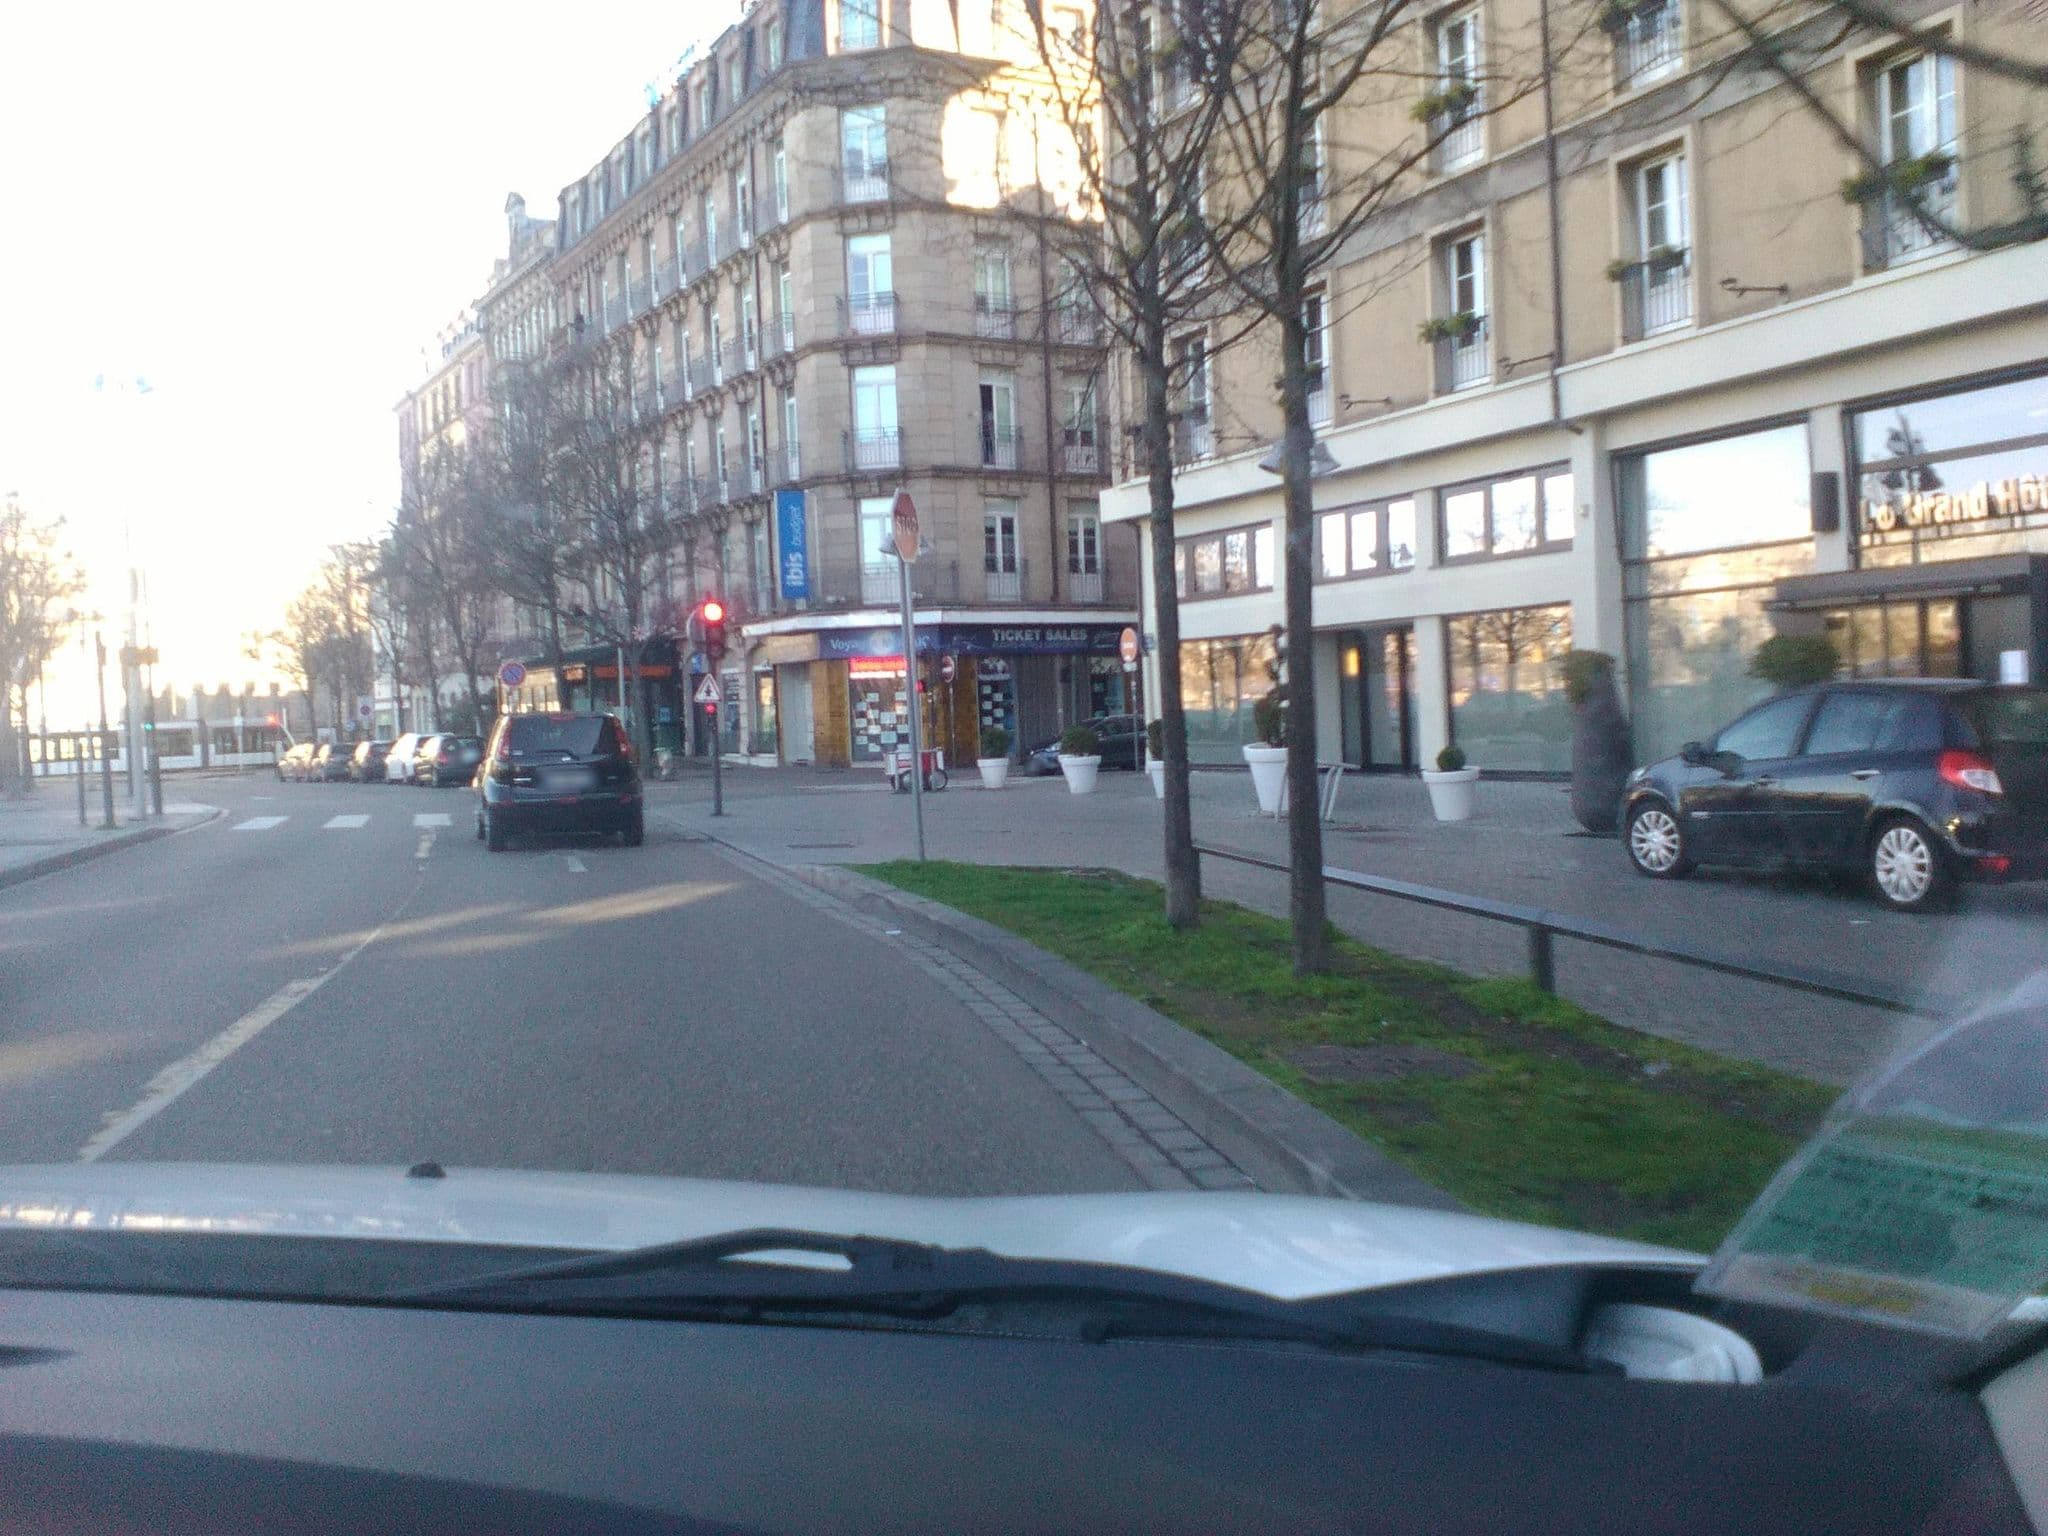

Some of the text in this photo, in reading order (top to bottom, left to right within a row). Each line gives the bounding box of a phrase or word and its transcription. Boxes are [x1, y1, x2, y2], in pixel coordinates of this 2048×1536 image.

[1904, 480, 1987, 526] Grand
[896, 515, 917, 536] STOP
[785, 504, 804, 586] ibis budget
[992, 628, 1041, 641] TICKET
[1045, 628, 1088, 641] SALES
